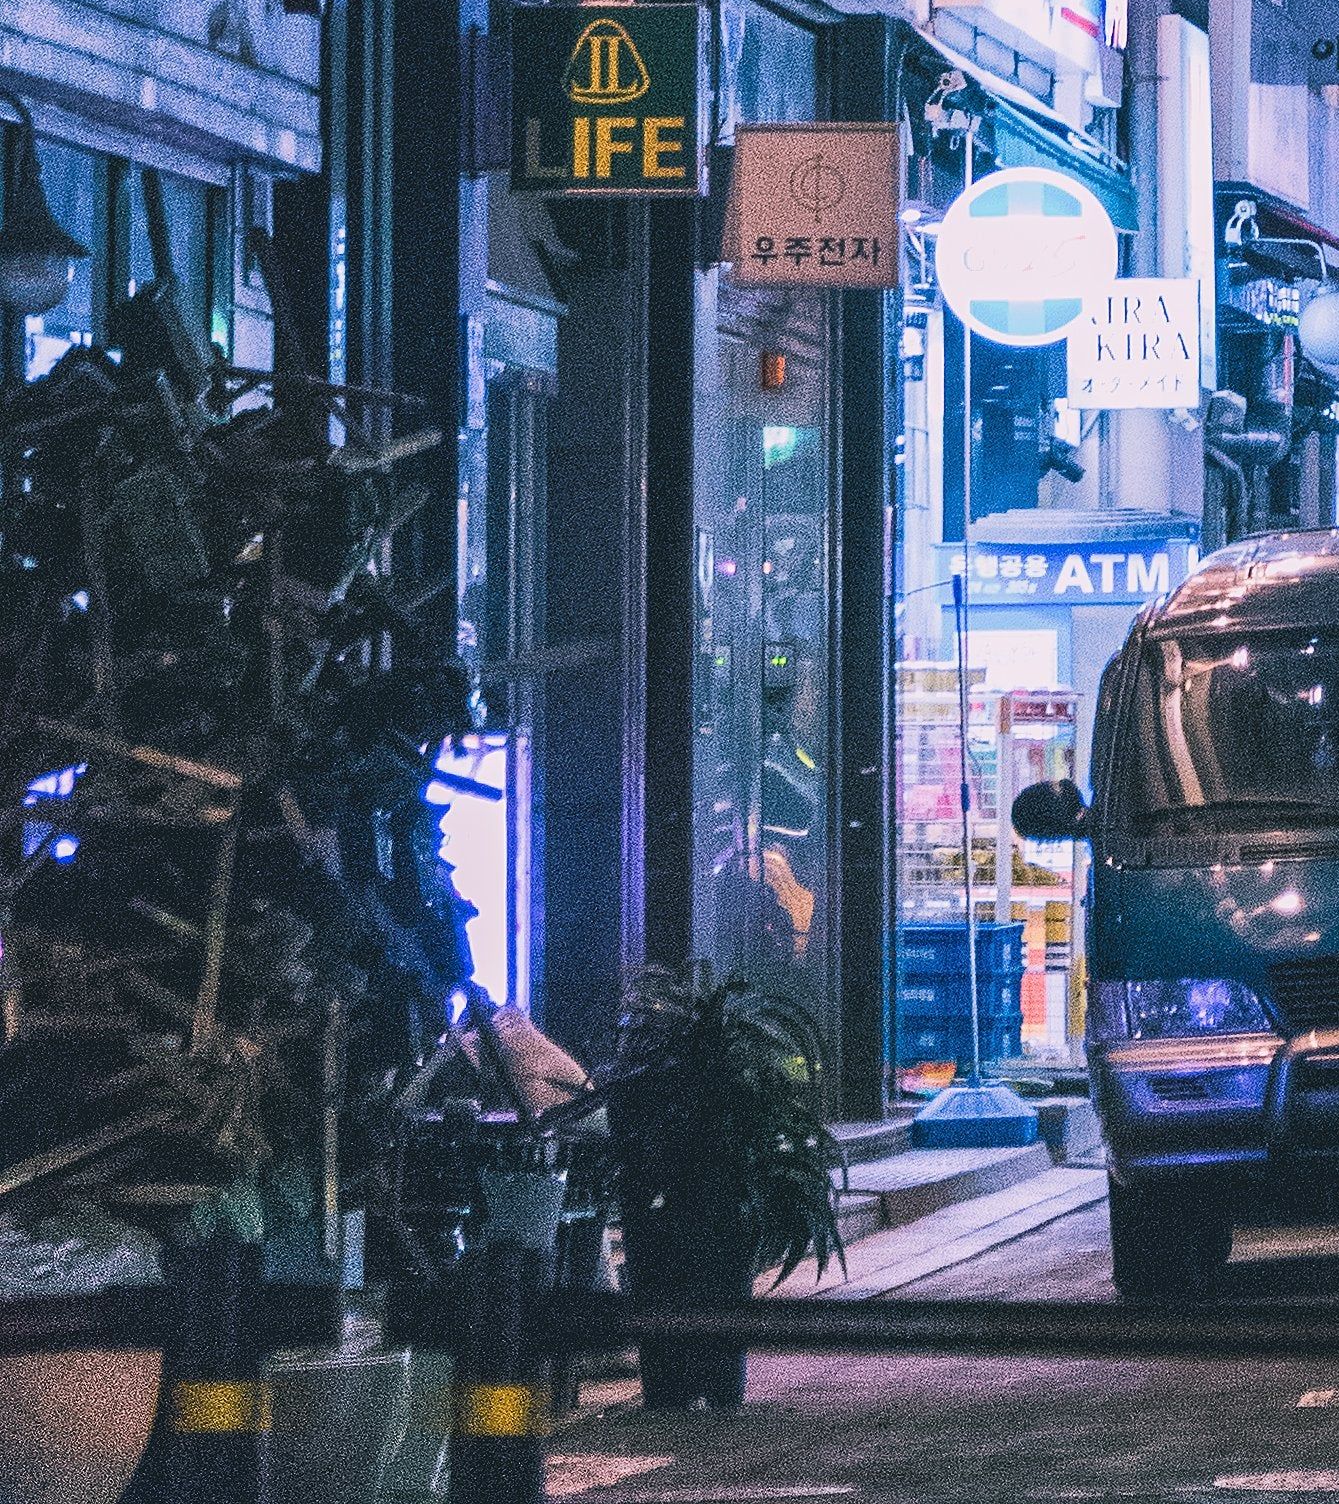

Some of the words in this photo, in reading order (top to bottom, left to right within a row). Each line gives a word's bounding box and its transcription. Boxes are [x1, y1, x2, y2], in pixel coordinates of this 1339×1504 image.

[525, 116, 687, 180] LIFE
[750, 234, 881, 269] 우주전자
[1091, 295, 1172, 325] IRA
[1096, 332, 1191, 362] KIRA
[1053, 553, 1170, 595] ATM
